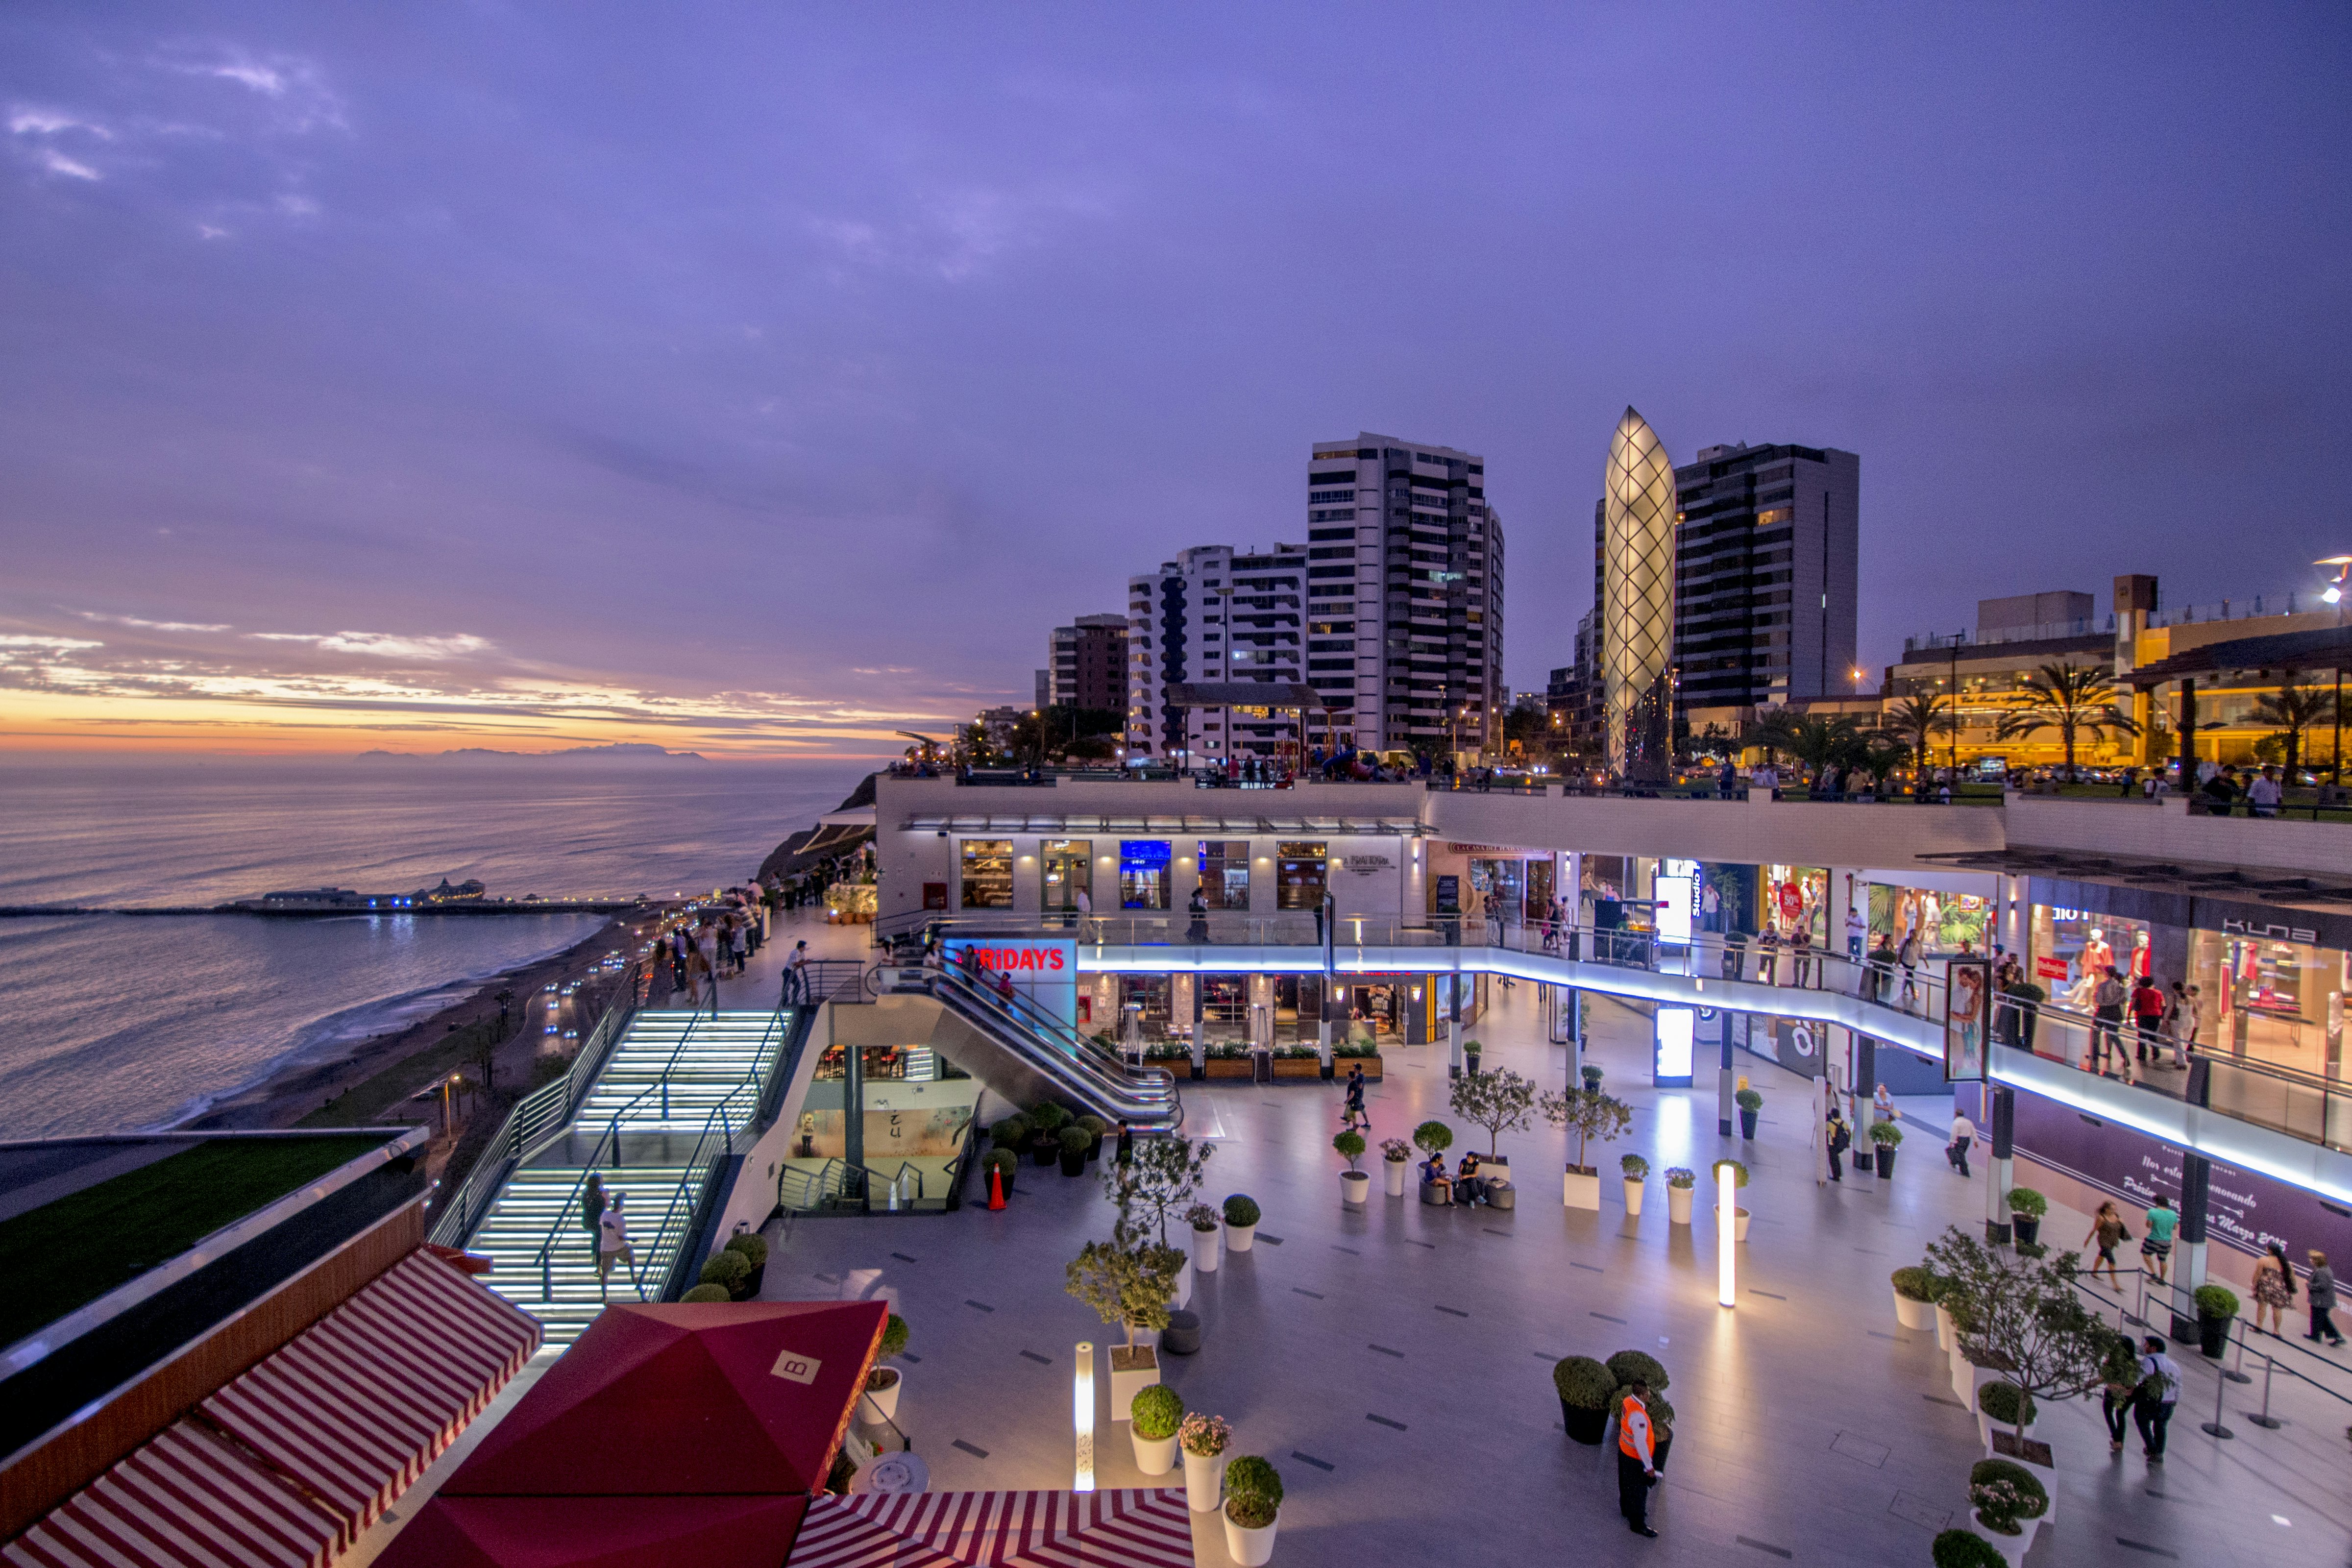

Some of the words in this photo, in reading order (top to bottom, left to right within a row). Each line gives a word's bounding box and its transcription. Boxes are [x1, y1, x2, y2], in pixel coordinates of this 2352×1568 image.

[1692, 873, 1701, 917] Studio
[1785, 894, 1799, 906] 50%
[2038, 960, 2067, 974] Rebajas
[2164, 1166, 2183, 1179] esta
[2207, 1184, 2257, 1208] enovando
[2124, 1176, 2157, 1197] Próxim
[2218, 1215, 2255, 1241] Marzo
[784, 1360, 808, 1376] B
